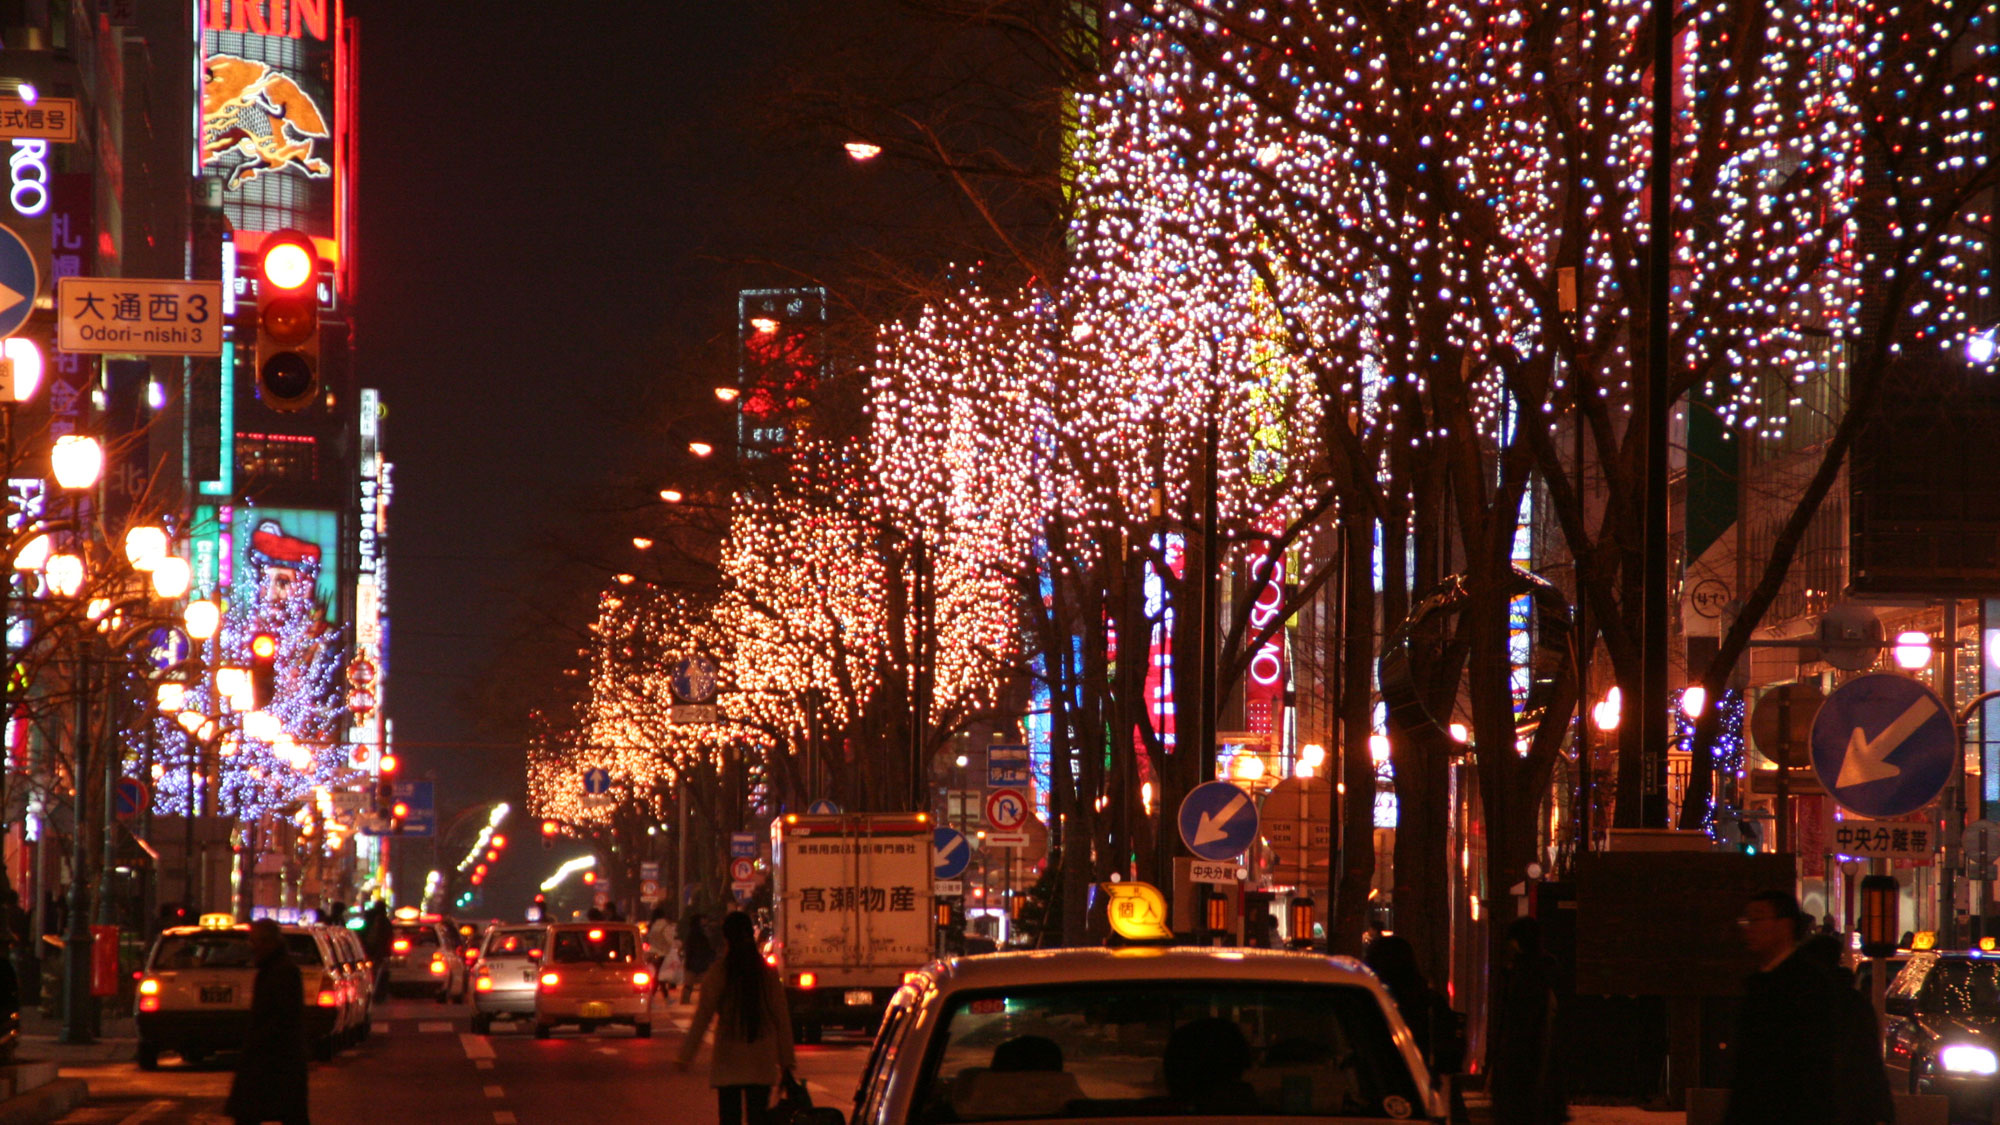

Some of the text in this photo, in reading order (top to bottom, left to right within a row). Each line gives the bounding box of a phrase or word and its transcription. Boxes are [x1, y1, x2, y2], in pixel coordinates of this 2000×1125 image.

[0, 109, 66, 130] 式信号
[74, 291, 208, 323] 大通西3
[80, 324, 203, 343] Odori-nishi 3
[1836, 827, 1927, 854] 中央分離帯
[1193, 866, 1237, 881] 中央分離
[1119, 902, 1158, 918] 個人
